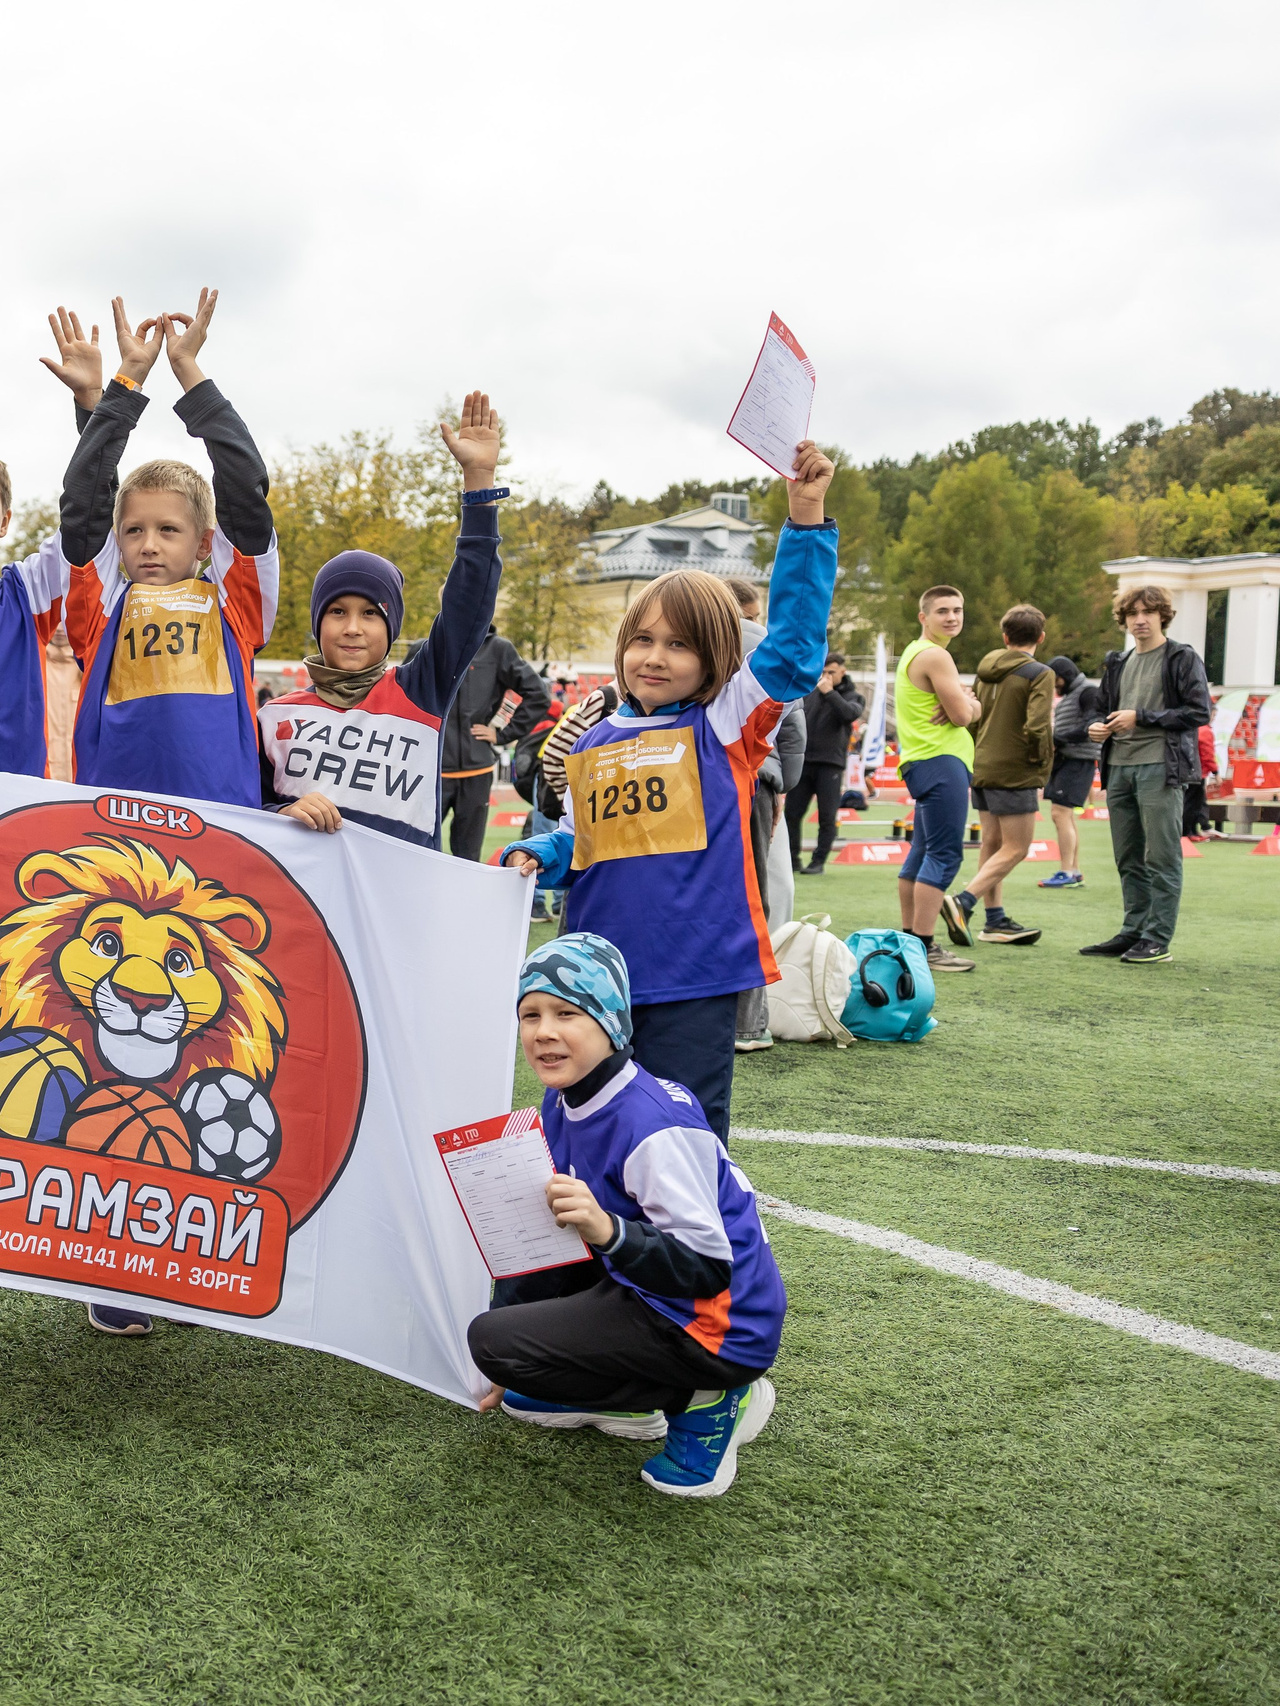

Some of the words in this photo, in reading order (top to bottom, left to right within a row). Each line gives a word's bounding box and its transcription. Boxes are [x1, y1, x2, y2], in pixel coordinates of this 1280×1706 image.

[123, 621, 201, 660] 1237
[294, 719, 419, 761] YACHT
[638, 746, 673, 754] ОБОРОНЕ»
[284, 747, 424, 801] CREW
[108, 797, 192, 833] ШСК
[587, 776, 668, 824] 1238
[57, 1240, 117, 1269] №141
[123, 1252, 158, 1277] ИМ.
[165, 1261, 181, 1282] Р.
[188, 1266, 252, 1295] ЗОРГЕ
